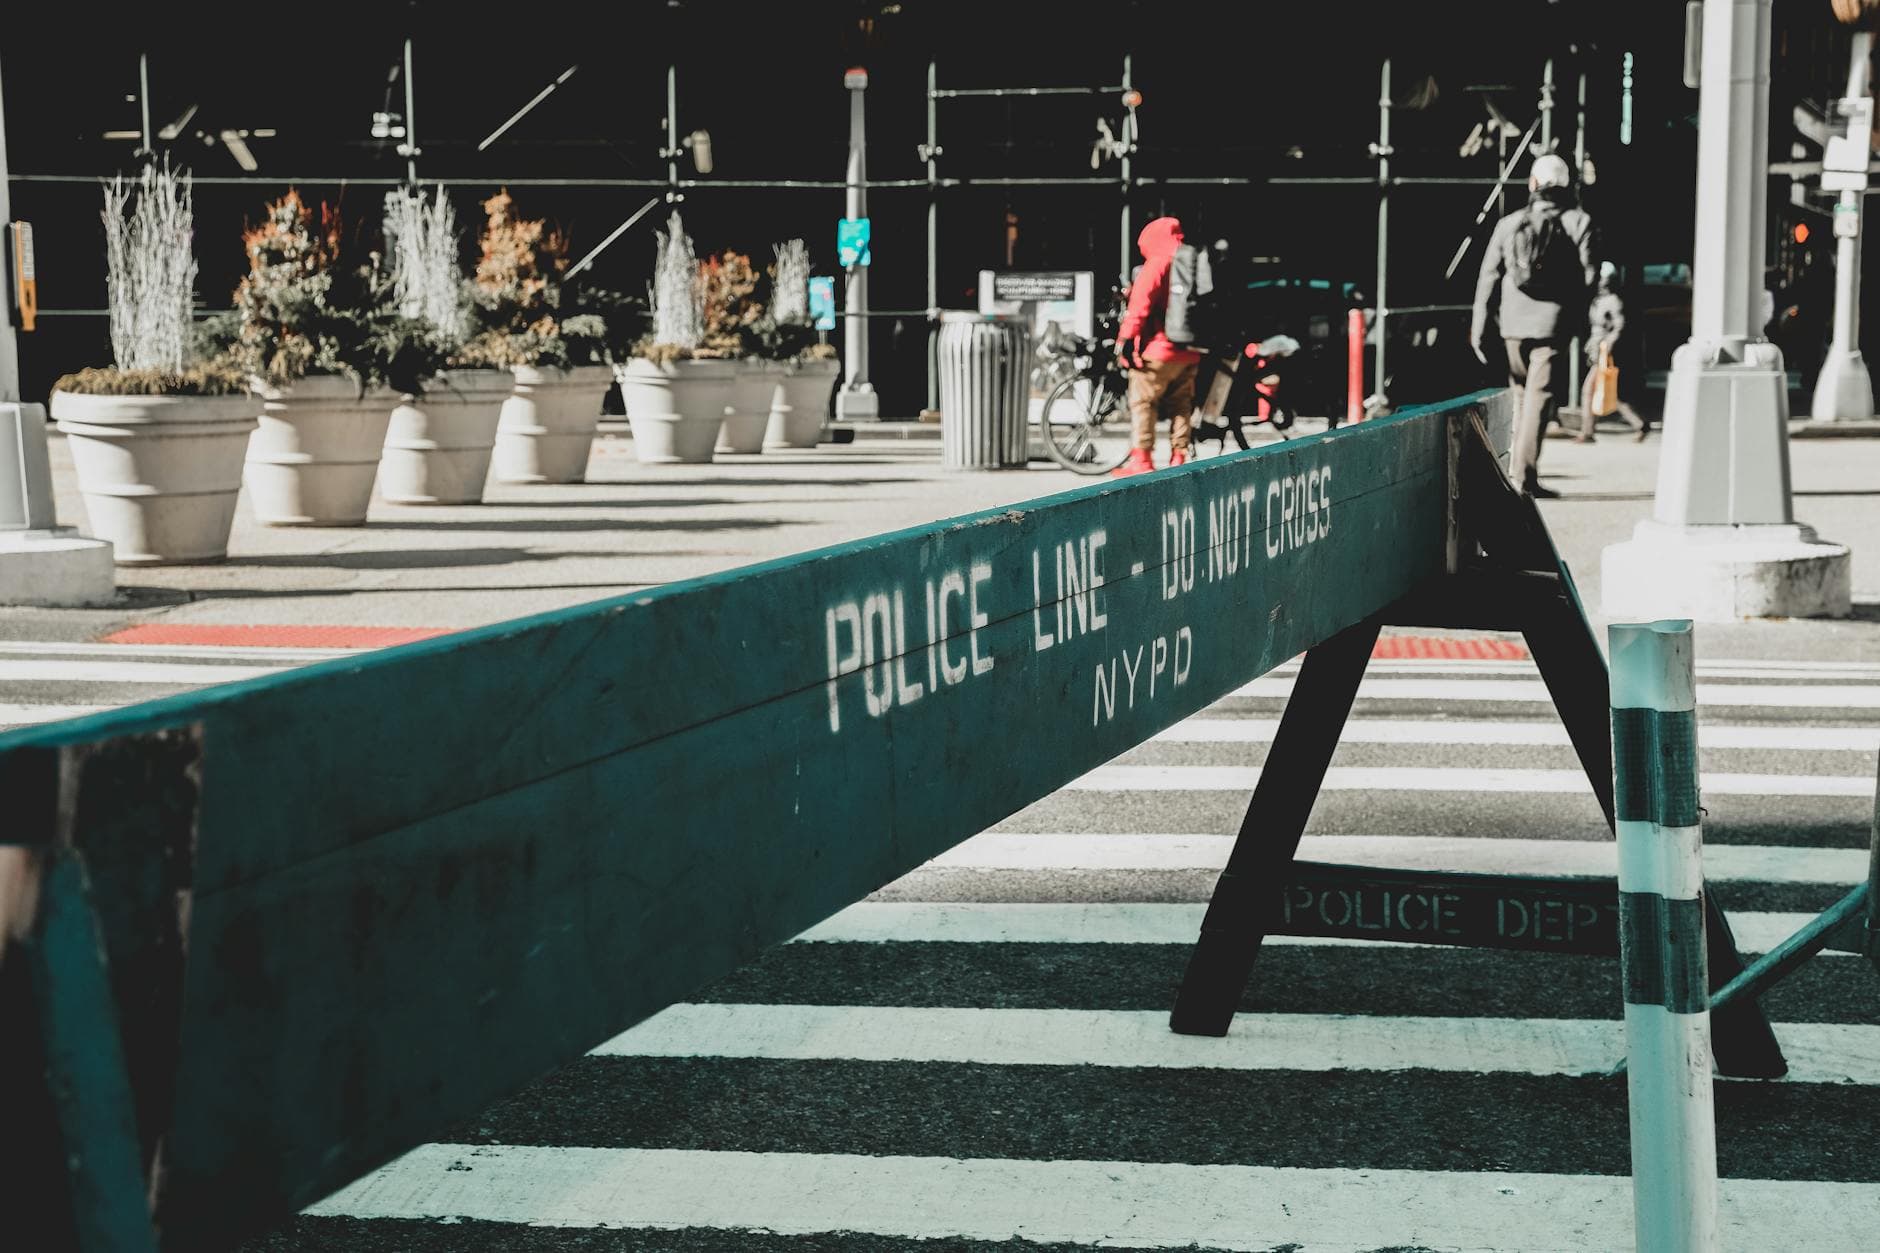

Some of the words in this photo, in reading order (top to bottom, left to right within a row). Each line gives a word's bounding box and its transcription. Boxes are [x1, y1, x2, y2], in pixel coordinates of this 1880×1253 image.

[825, 562, 995, 733] POLICE
[1032, 530, 1108, 652] LINE
[1162, 505, 1195, 601] DO
[1208, 485, 1256, 584] NOT
[1266, 465, 1332, 560] CROSS
[1093, 625, 1192, 727] NYPD
[1282, 884, 1464, 936] POLICE
[1495, 897, 1618, 942] DEP
